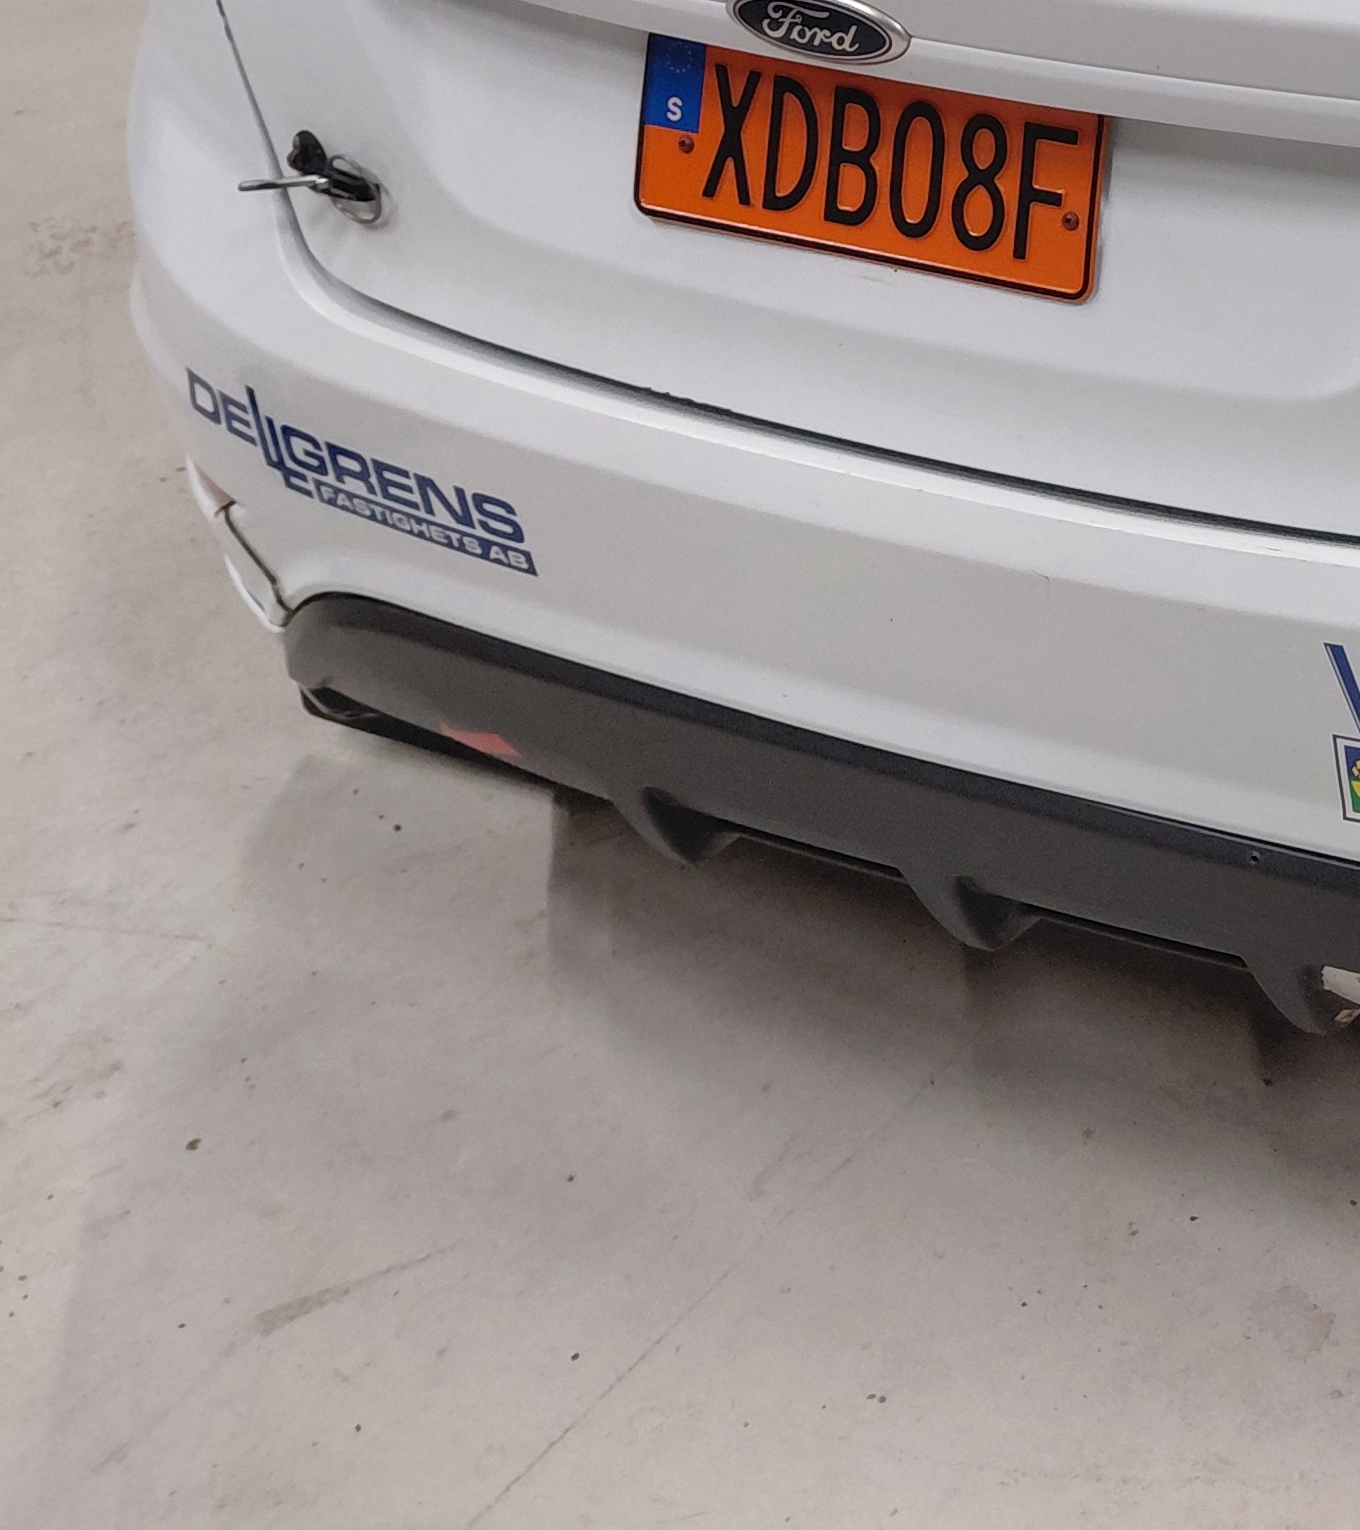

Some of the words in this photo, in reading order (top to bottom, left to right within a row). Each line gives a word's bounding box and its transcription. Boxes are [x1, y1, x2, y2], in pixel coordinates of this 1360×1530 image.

[761, 0, 860, 54] Ford
[665, 97, 683, 122] S
[701, 63, 1079, 261] XDB08F
[321, 486, 484, 556] FASTIGHETS
[488, 545, 530, 570] AB
